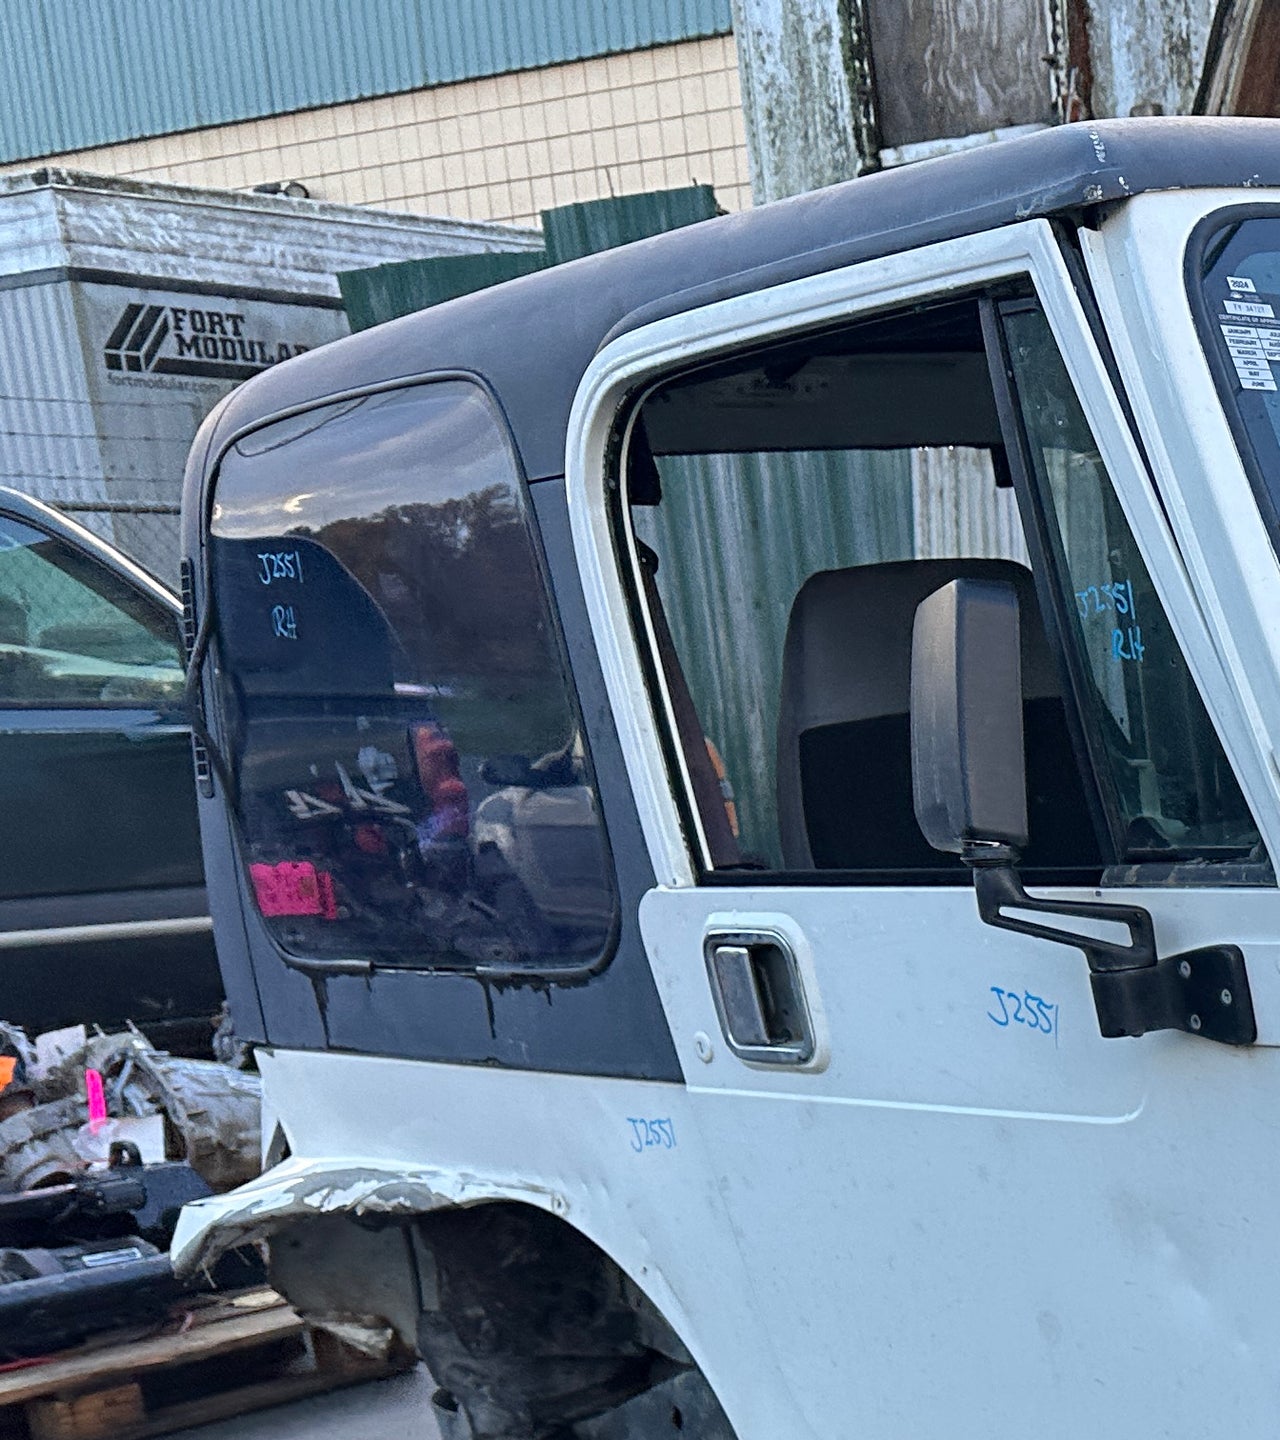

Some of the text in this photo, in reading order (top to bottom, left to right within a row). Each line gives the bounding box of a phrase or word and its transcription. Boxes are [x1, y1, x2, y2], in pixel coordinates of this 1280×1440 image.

[170, 307, 246, 337] FORT
[257, 551, 304, 585] J2551
[1075, 579, 1136, 620] J2551
[1111, 626, 1145, 663] RH
[987, 986, 1059, 1050] J2551
[626, 1118, 677, 1153] J2551
